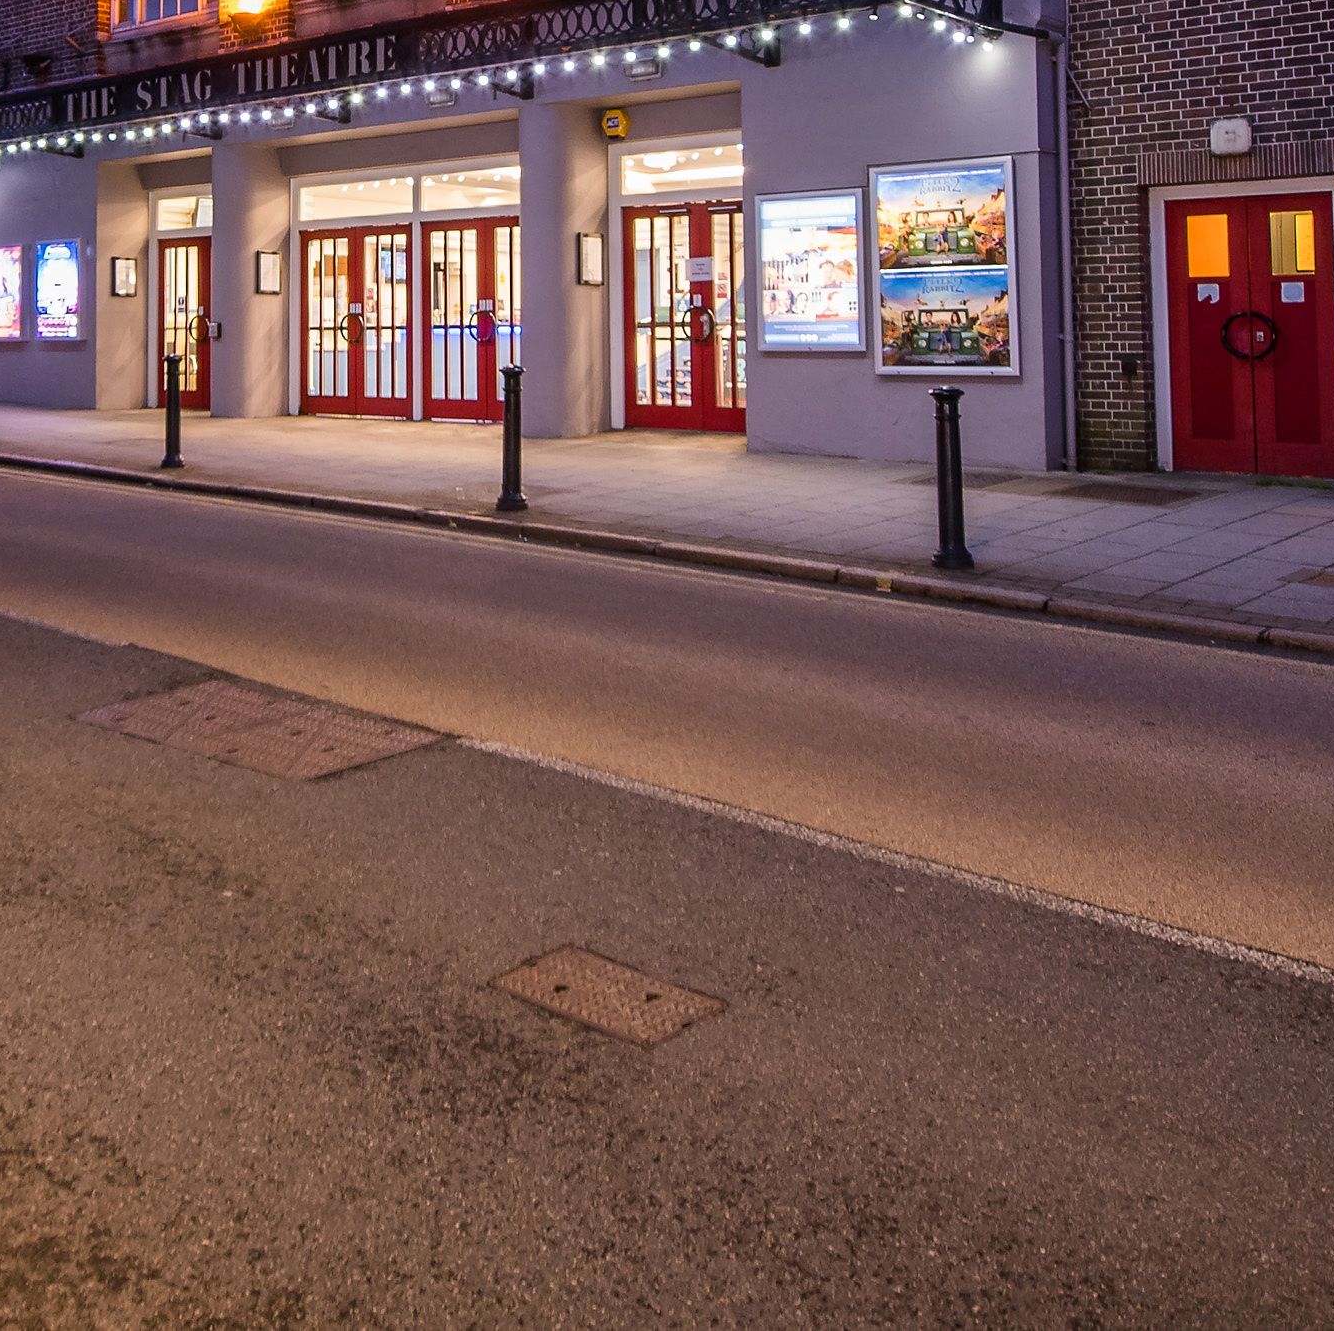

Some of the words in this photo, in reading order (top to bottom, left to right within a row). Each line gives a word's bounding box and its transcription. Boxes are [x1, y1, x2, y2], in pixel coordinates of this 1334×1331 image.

[65, 85, 116, 122] THE
[137, 69, 212, 112] STAG
[232, 34, 396, 96] THEATRE
[920, 185, 952, 195] RABBIT
[922, 285, 955, 294] RABBIT
